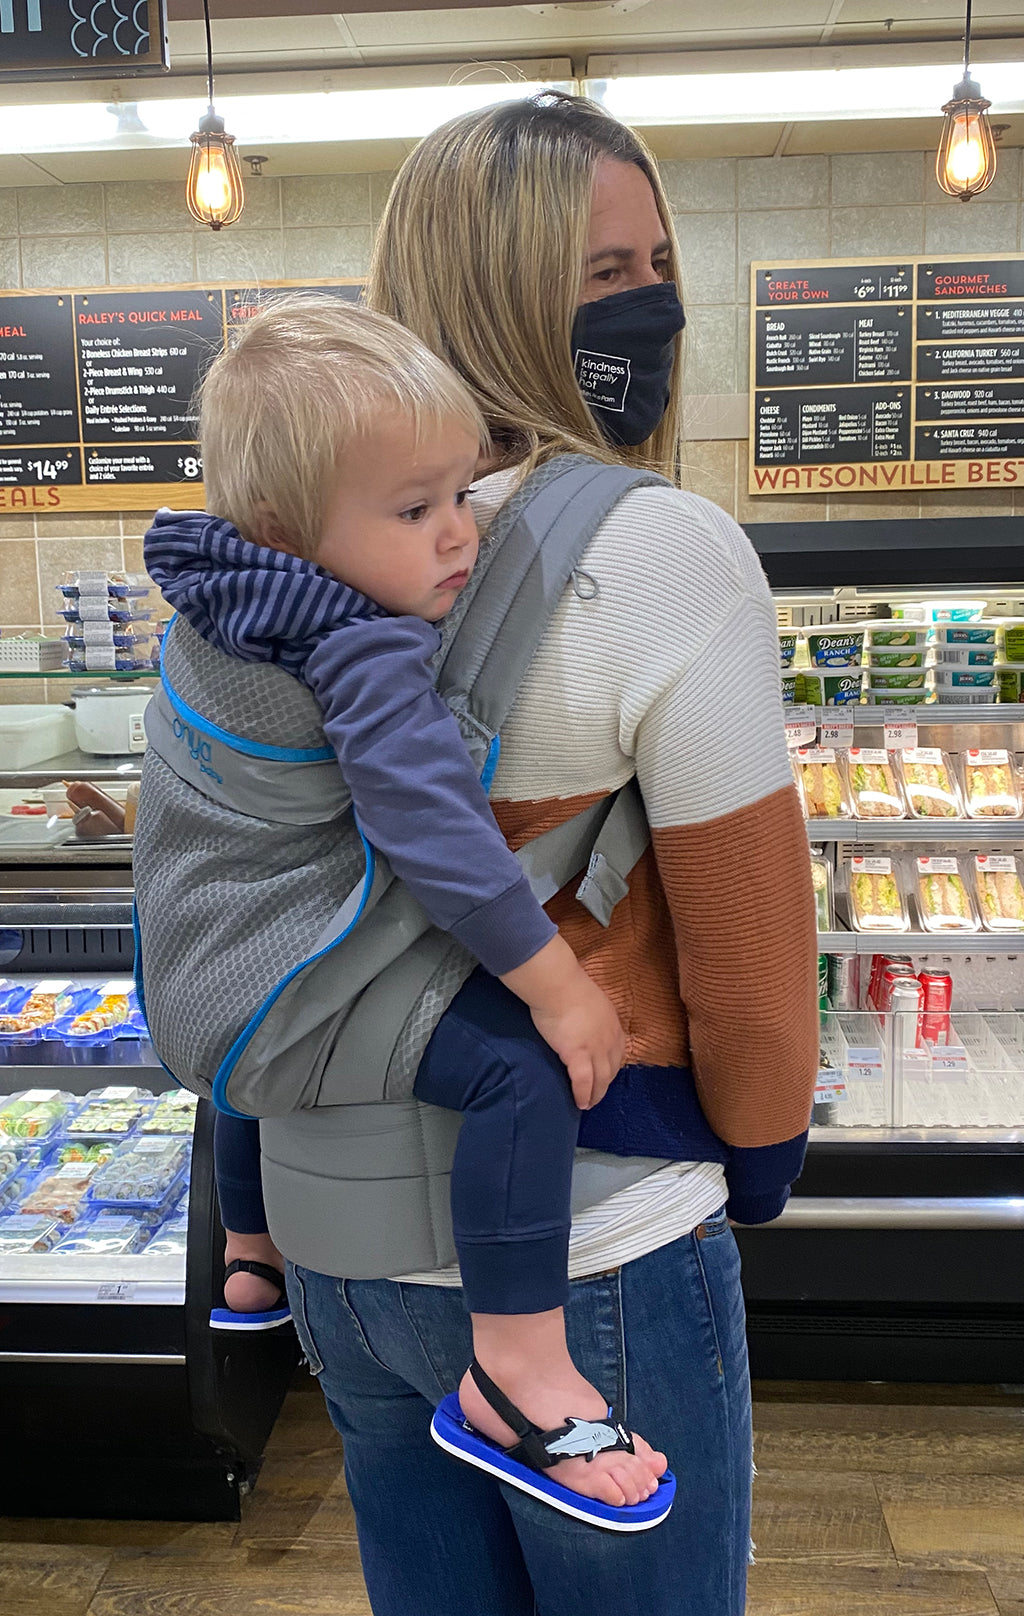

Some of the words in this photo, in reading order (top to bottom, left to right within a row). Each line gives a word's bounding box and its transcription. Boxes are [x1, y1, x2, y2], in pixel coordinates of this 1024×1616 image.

[768, 280, 810, 291] CREATE
[934, 274, 990, 286] GOURMET
[768, 291, 798, 301] YOUR
[802, 290, 830, 300] OWN
[934, 284, 1008, 296] SANDWICHES
[78, 312, 125, 324] RALEY'S
[128, 310, 167, 324] QUICK
[170, 310, 203, 321] MEAL
[935, 310, 940, 320] 1.
[942, 309, 989, 319] MEDITERRANEAN
[990, 308, 1010, 318] VEGGIE
[766, 322, 785, 332] BREAD
[858, 319, 874, 328] MEAT
[81, 338, 94, 347] Your
[94, 338, 112, 346] choice
[82, 350, 86, 358] 2
[86, 350, 111, 358] Boneless
[111, 348, 132, 358] Chicken
[134, 348, 151, 358] Breast
[152, 348, 168, 358] Strips
[178, 347, 187, 356] cal
[934, 350, 941, 359] 2.
[942, 350, 975, 358] CALIFORNIA
[976, 348, 998, 358] TURKEY
[1000, 348, 1011, 357] 560
[1011, 348, 1020, 357] cal
[86, 360, 92, 368] or
[581, 358, 626, 375] kindness
[82, 368, 104, 378] 2-Piece
[104, 368, 122, 378] Breast
[122, 367, 127, 376] &
[128, 366, 144, 378] Wing
[154, 366, 163, 375] cal
[580, 368, 588, 378] is
[589, 372, 618, 384] really
[84, 387, 104, 396] 2-Piece
[104, 386, 133, 396] Drumstick
[133, 386, 138, 394] &
[139, 385, 156, 395] Thigh
[167, 385, 176, 394] cal
[934, 391, 940, 400] 3.
[941, 390, 971, 399] DAGWOOD
[974, 390, 985, 398] 920
[985, 390, 994, 398] cal
[85, 405, 100, 416] Daily
[100, 404, 118, 414] Entrée
[118, 404, 147, 414] Selections
[760, 405, 780, 415] CHEESE
[802, 403, 837, 414] CONDIMENTS
[875, 401, 902, 411] ADD-ONS
[934, 430, 940, 438] 4.
[941, 430, 959, 438] SANTA
[960, 429, 974, 438] CRUZ
[989, 429, 998, 437] cal
[88, 457, 112, 465] Customize
[123, 456, 135, 464] meal
[136, 456, 146, 464] with
[88, 465, 104, 473] choice
[104, 464, 110, 472] of
[120, 464, 138, 472] favorite
[89, 472, 98, 480] and
[98, 472, 102, 480] 2
[754, 463, 956, 490] WATSONVILLE
[819, 636, 854, 650] Dean's
[824, 648, 850, 657] RANCH
[824, 730, 839, 738] 2.98
[888, 730, 902, 738] 2.98
[172, 718, 212, 763] onya
[943, 1060, 956, 1068] 1.29
[858, 1068, 872, 1076] 1.29
